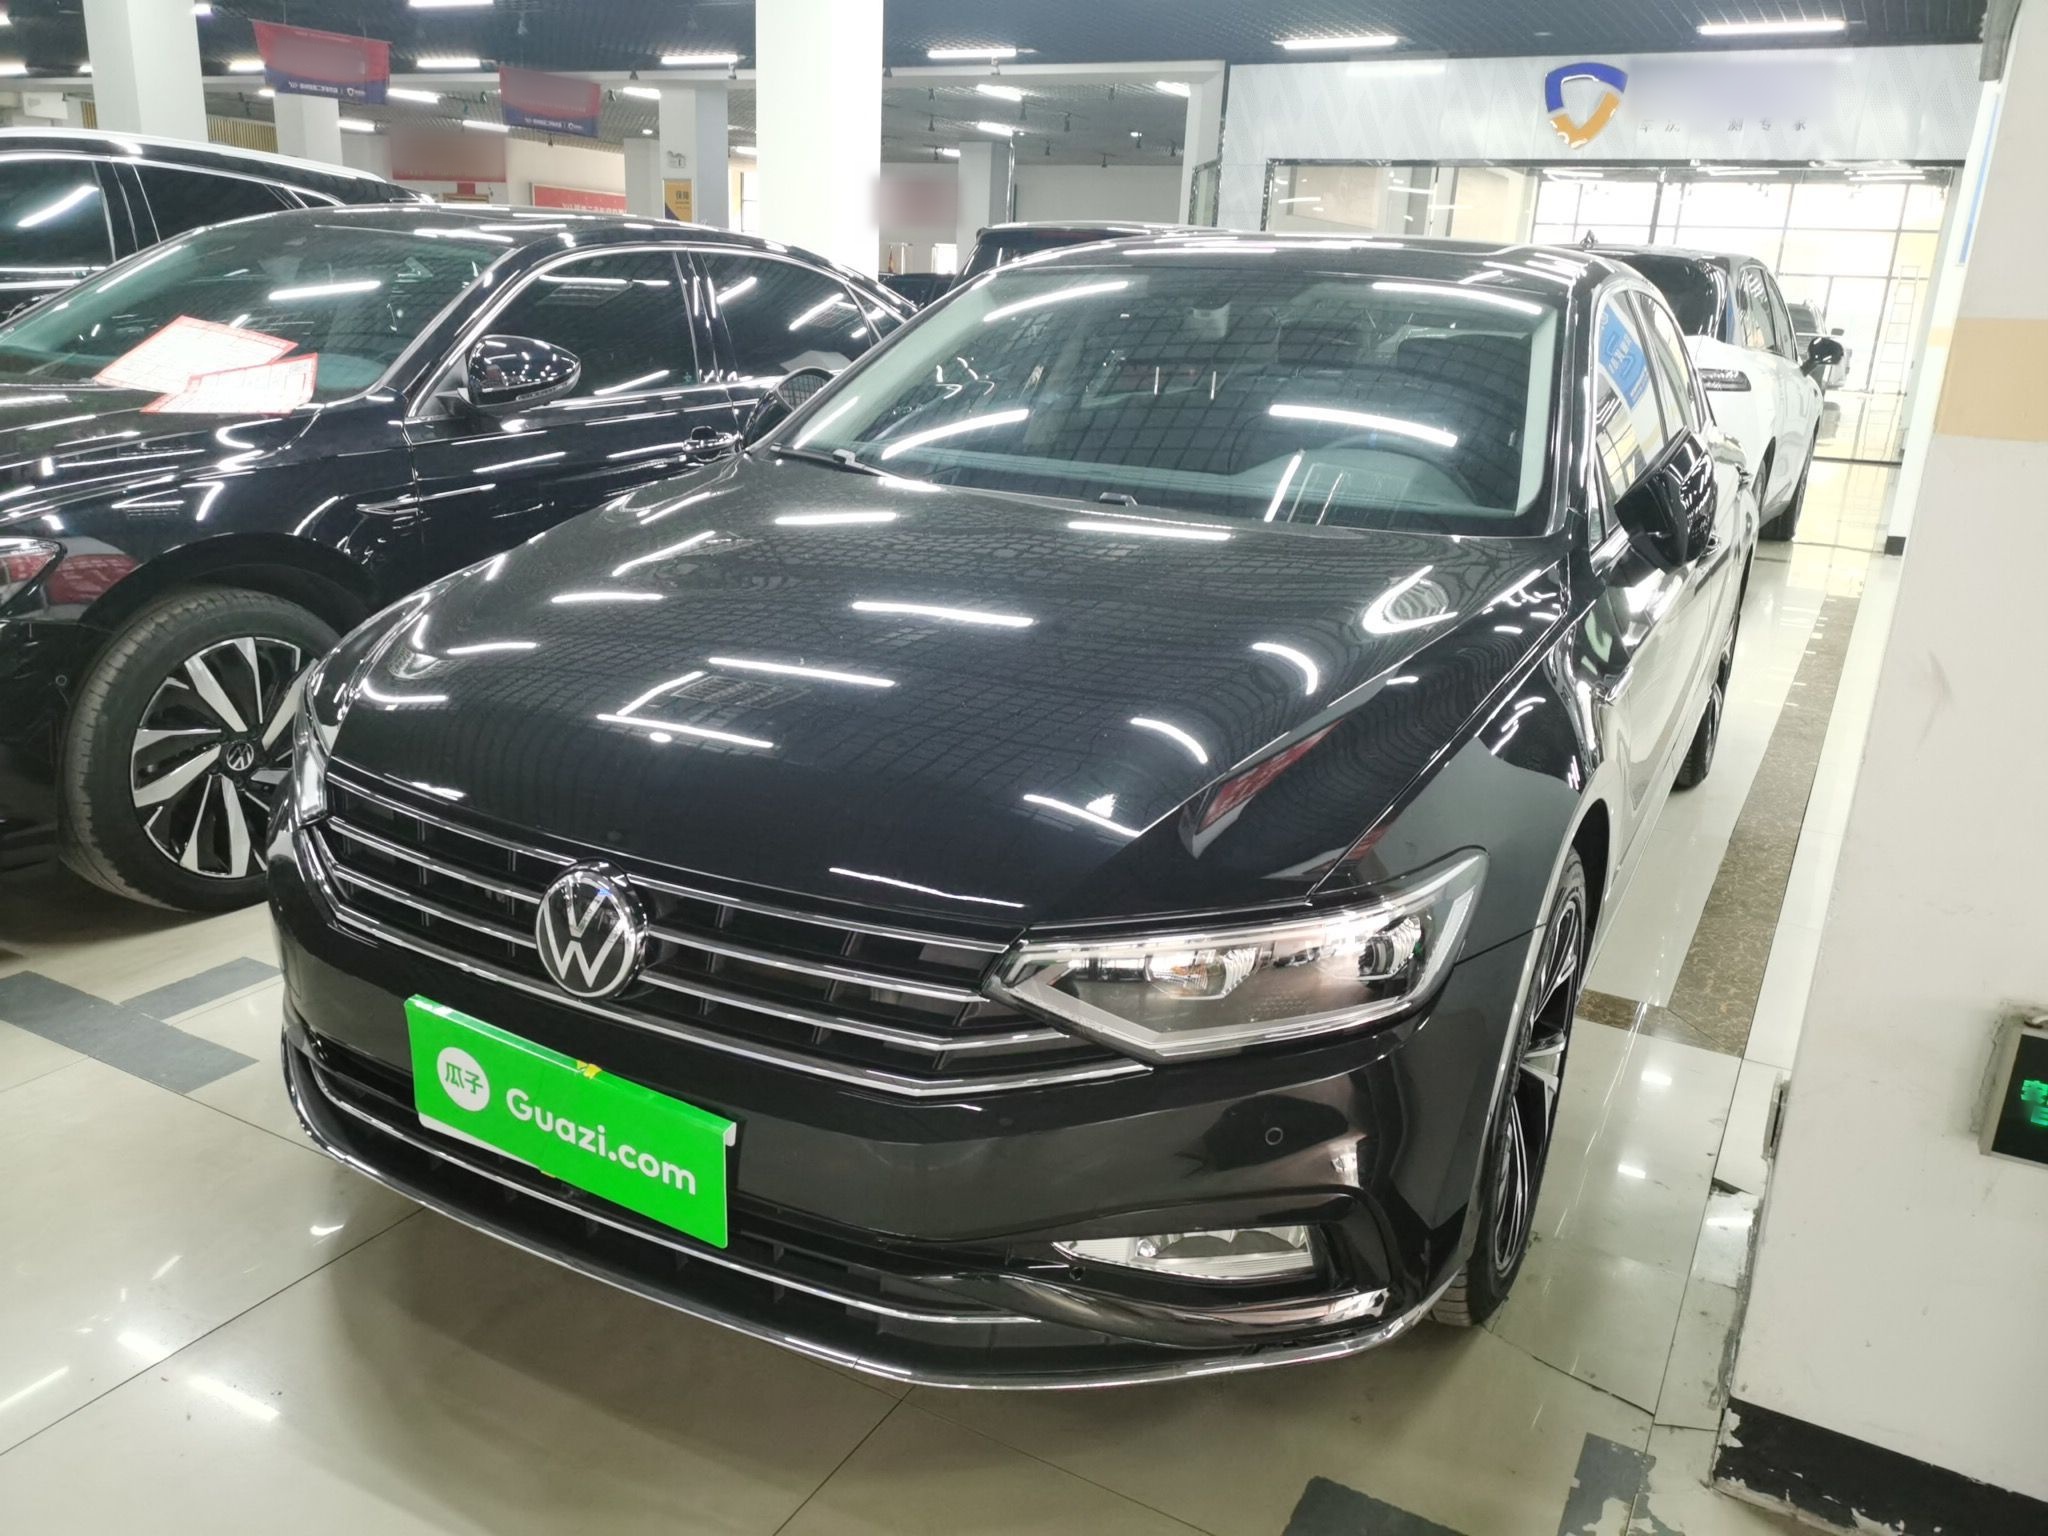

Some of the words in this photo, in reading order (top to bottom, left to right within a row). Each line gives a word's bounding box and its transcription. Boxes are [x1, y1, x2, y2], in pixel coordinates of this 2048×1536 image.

[537, 874, 635, 996] VW
[445, 1061, 484, 1095] 瓜子
[506, 1087, 696, 1196] Guazi.com
